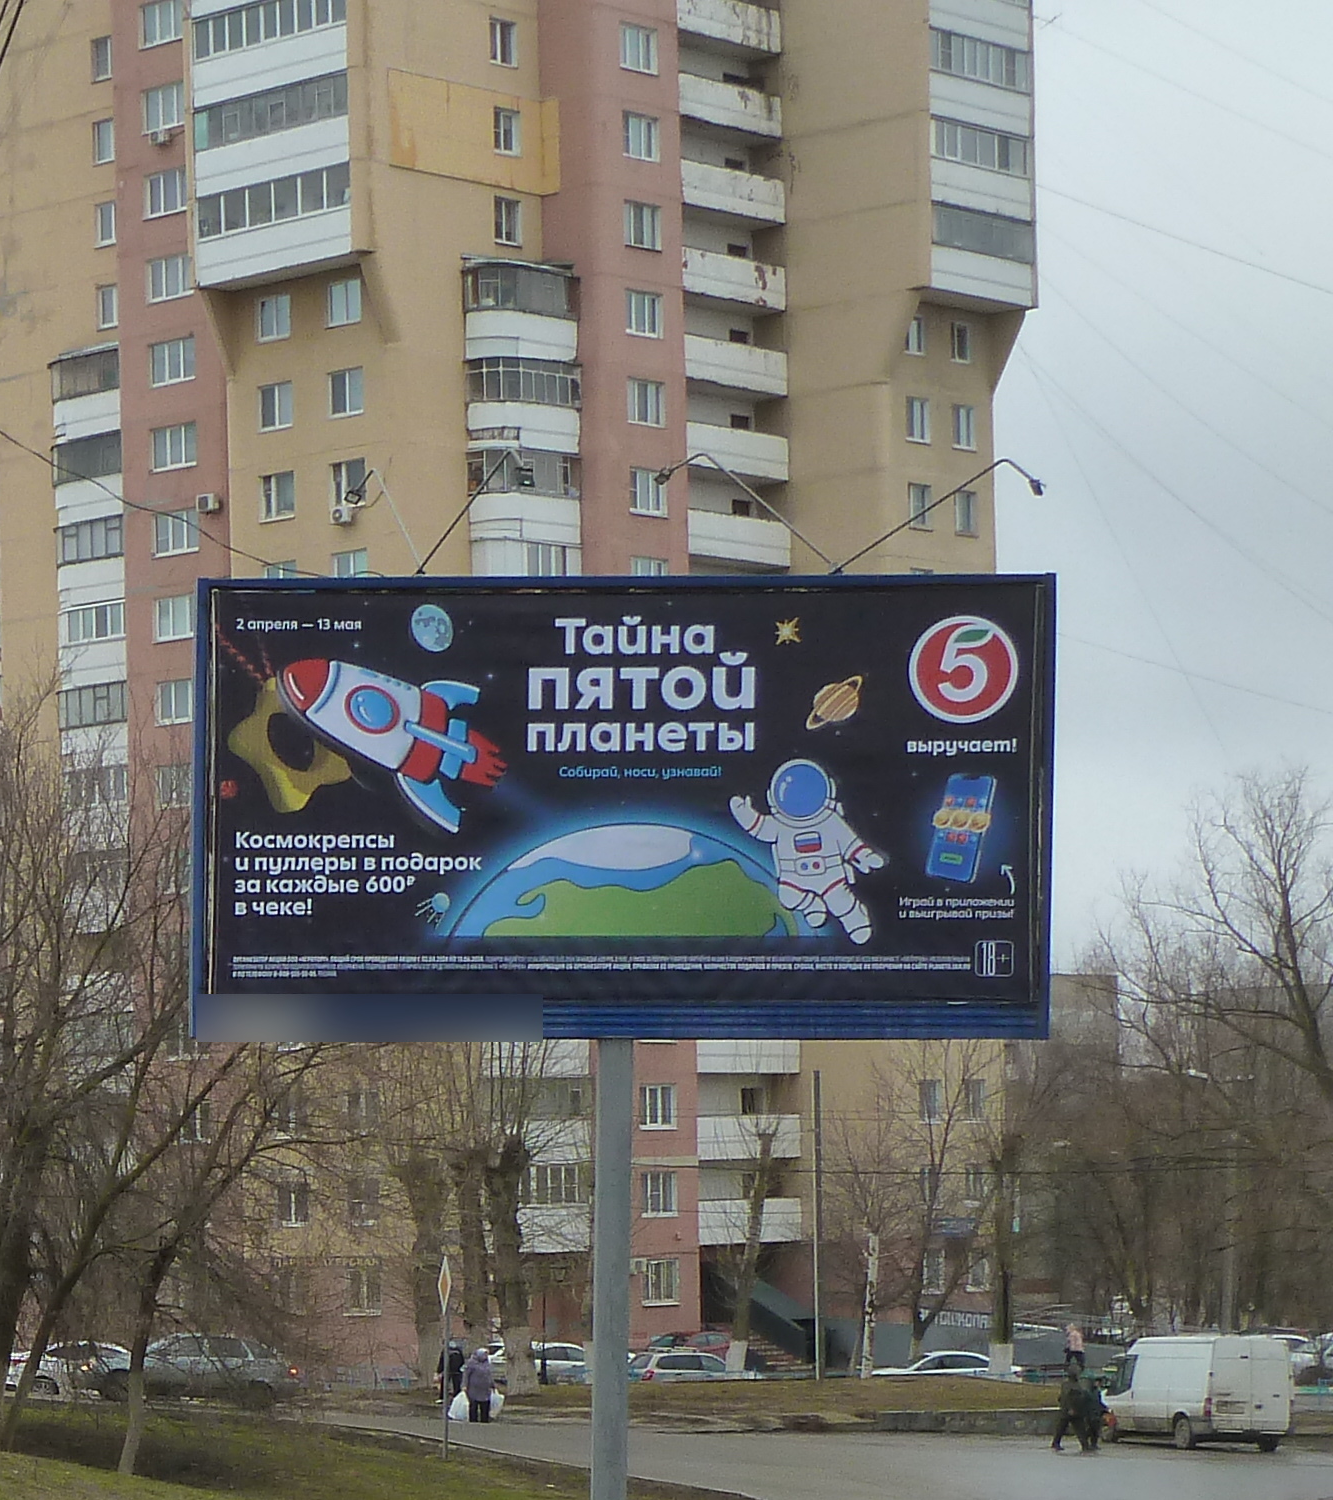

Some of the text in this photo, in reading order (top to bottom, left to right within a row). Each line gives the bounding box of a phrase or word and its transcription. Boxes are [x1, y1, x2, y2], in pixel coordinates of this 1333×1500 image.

[235, 618, 245, 630] 2
[247, 619, 298, 633] апреля
[316, 618, 331, 630] 13
[333, 620, 362, 630] мая
[554, 615, 715, 655] Тайна
[528, 651, 756, 711] пятой
[526, 721, 755, 752] планеты
[906, 737, 1018, 756] выручает!
[559, 765, 722, 780] Собирай, носи, узнавай!
[234, 831, 396, 853] Космокрепсы
[234, 852, 482, 875] и пуллеры в подарок
[234, 878, 261, 893] за
[266, 875, 360, 893] каждые
[234, 898, 313, 915] в чеке!
[899, 896, 1015, 909] Играй в приложении
[898, 908, 1014, 920] и выигрывай призы!
[981, 942, 1011, 976] 18+
